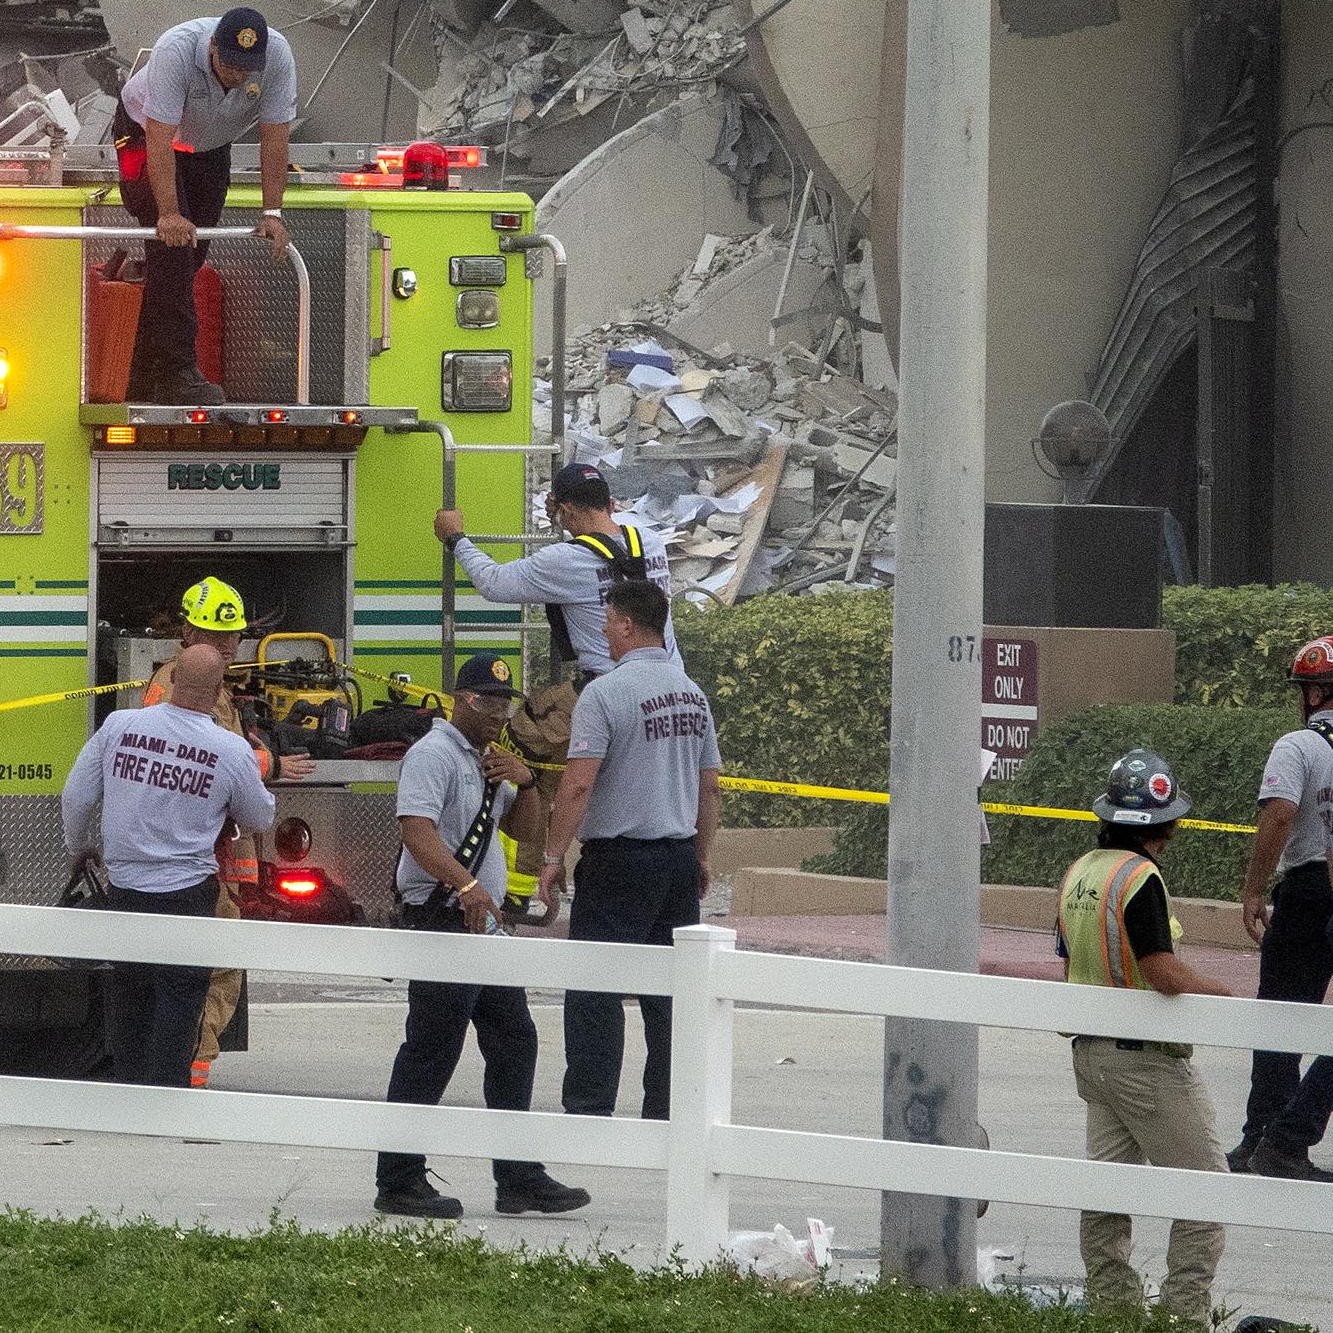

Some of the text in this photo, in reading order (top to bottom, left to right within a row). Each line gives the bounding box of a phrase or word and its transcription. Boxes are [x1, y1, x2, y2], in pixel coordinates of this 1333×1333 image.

[167, 463, 282, 491] RESCUE
[948, 635, 981, 663] 87
[996, 643, 1022, 667] EXIT
[994, 675, 1024, 700] ONLY
[644, 716, 670, 742] FIRE
[988, 724, 1030, 749] DO NOT
[112, 752, 215, 799] FIRE RESCUE
[990, 757, 1024, 781] ENTE
